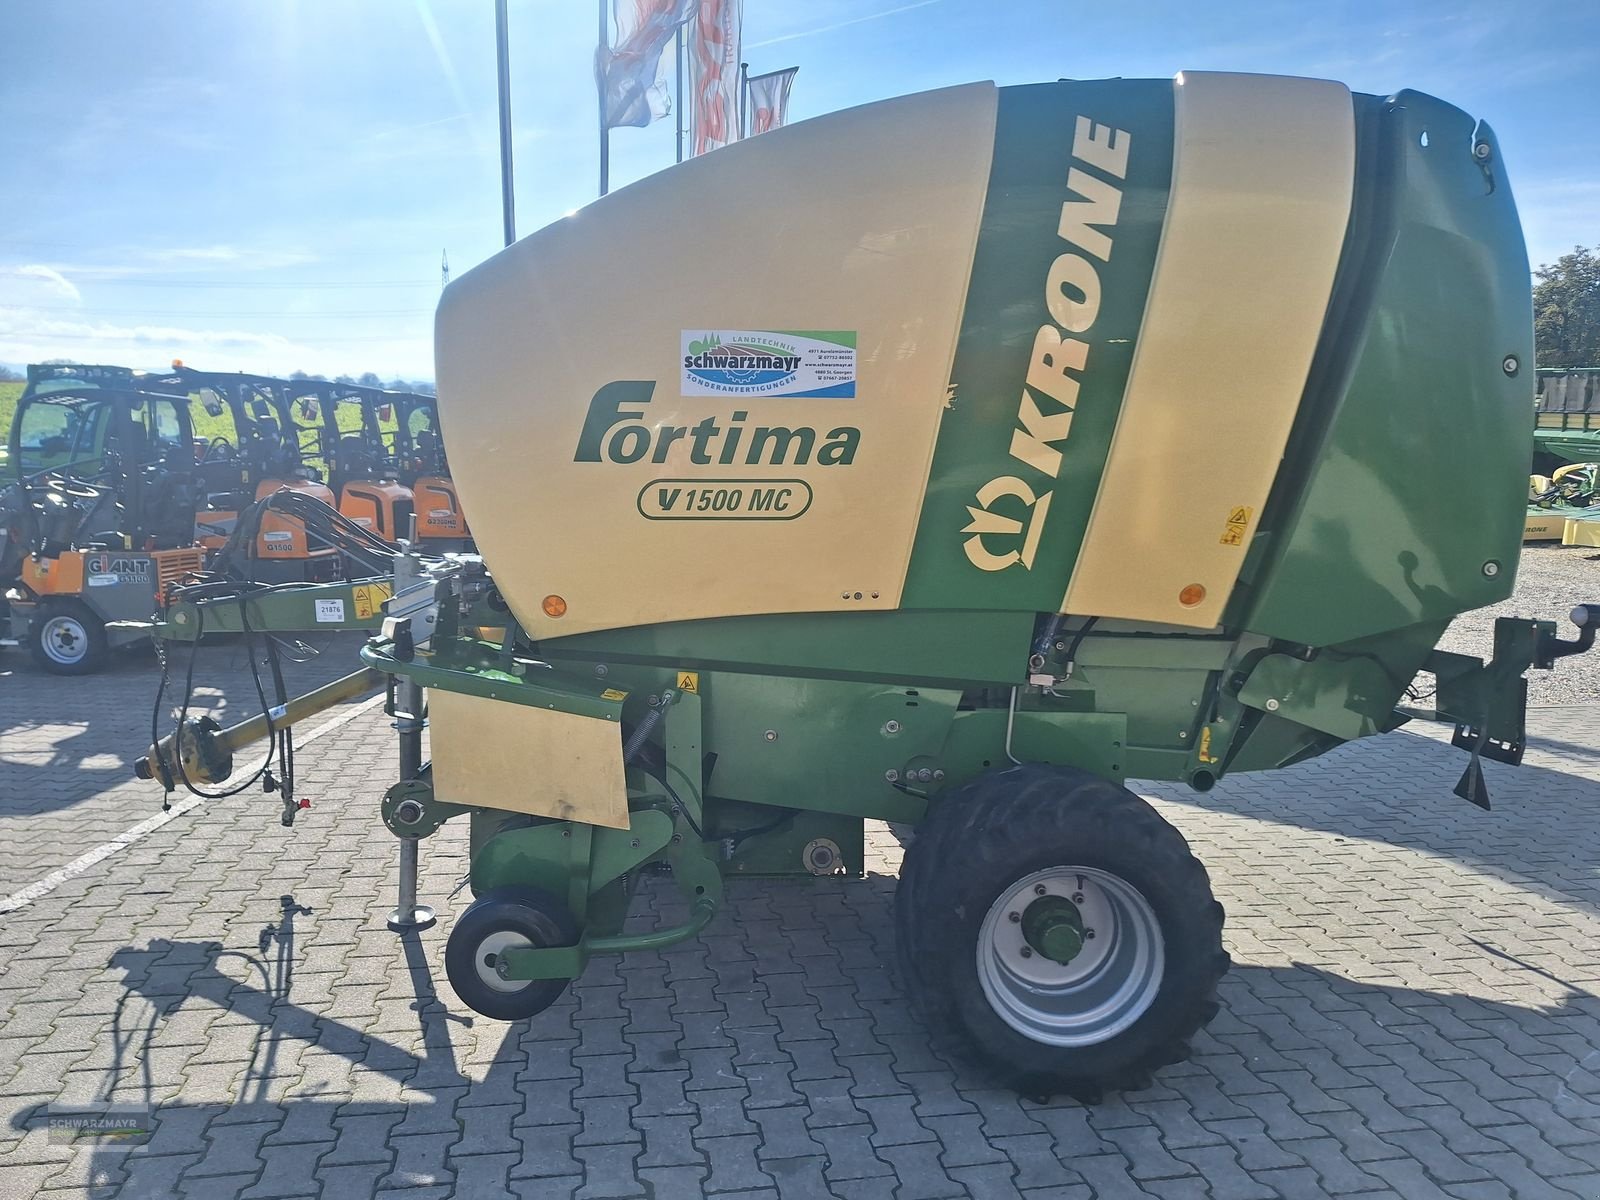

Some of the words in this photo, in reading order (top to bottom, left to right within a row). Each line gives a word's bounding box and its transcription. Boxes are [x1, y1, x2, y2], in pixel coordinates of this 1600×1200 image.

[1009, 115, 1131, 478] KRONE
[732, 336, 796, 353] LANDTECHNIK
[684, 352, 802, 371] schwarzmayr
[686, 373, 797, 393] SONDERANFERTIGUNGEN
[573, 380, 861, 466] Fortima
[658, 488, 682, 511] V
[686, 489, 742, 511] 1500
[748, 489, 792, 511] MC
